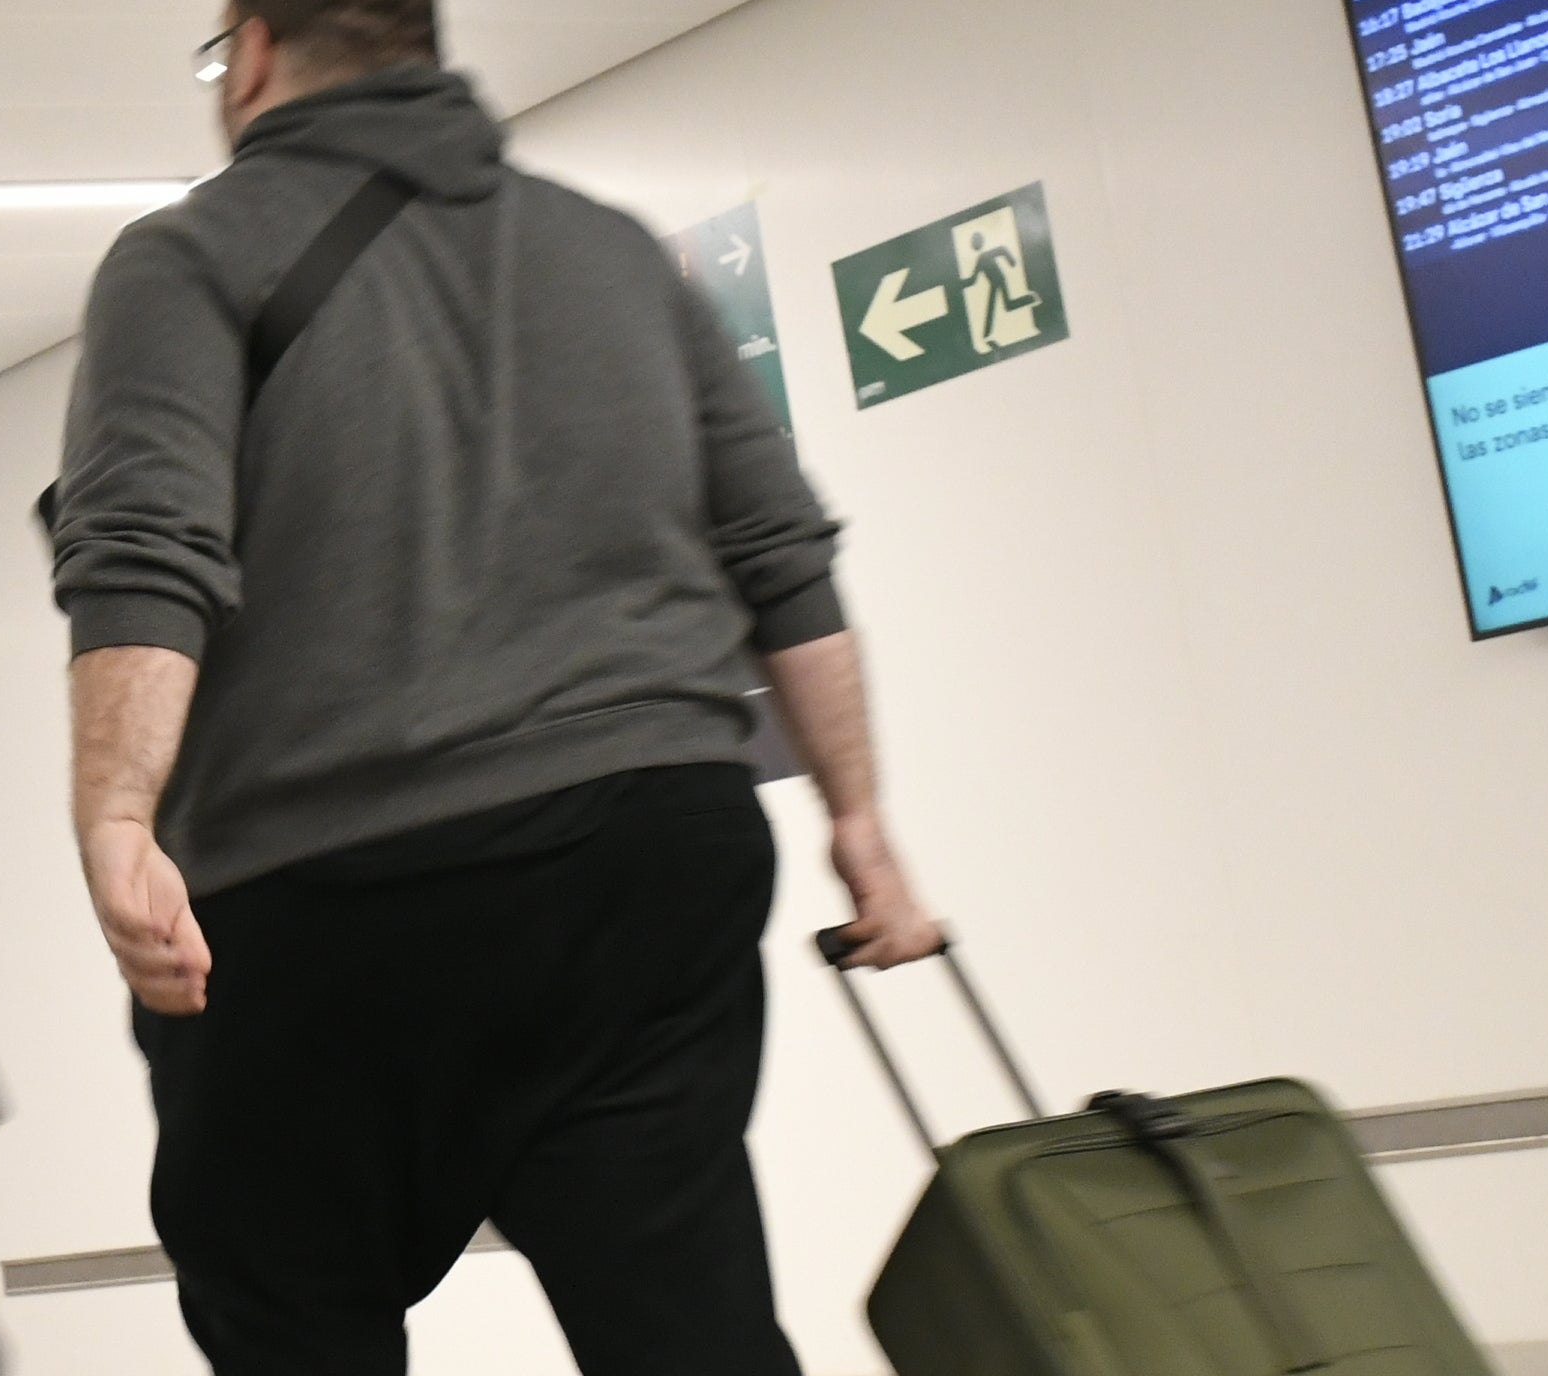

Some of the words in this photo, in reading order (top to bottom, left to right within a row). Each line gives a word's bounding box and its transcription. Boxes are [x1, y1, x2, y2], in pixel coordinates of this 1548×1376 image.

[1450, 406, 1480, 426] No
[1483, 398, 1507, 418] se
[1457, 440, 1487, 461] las
